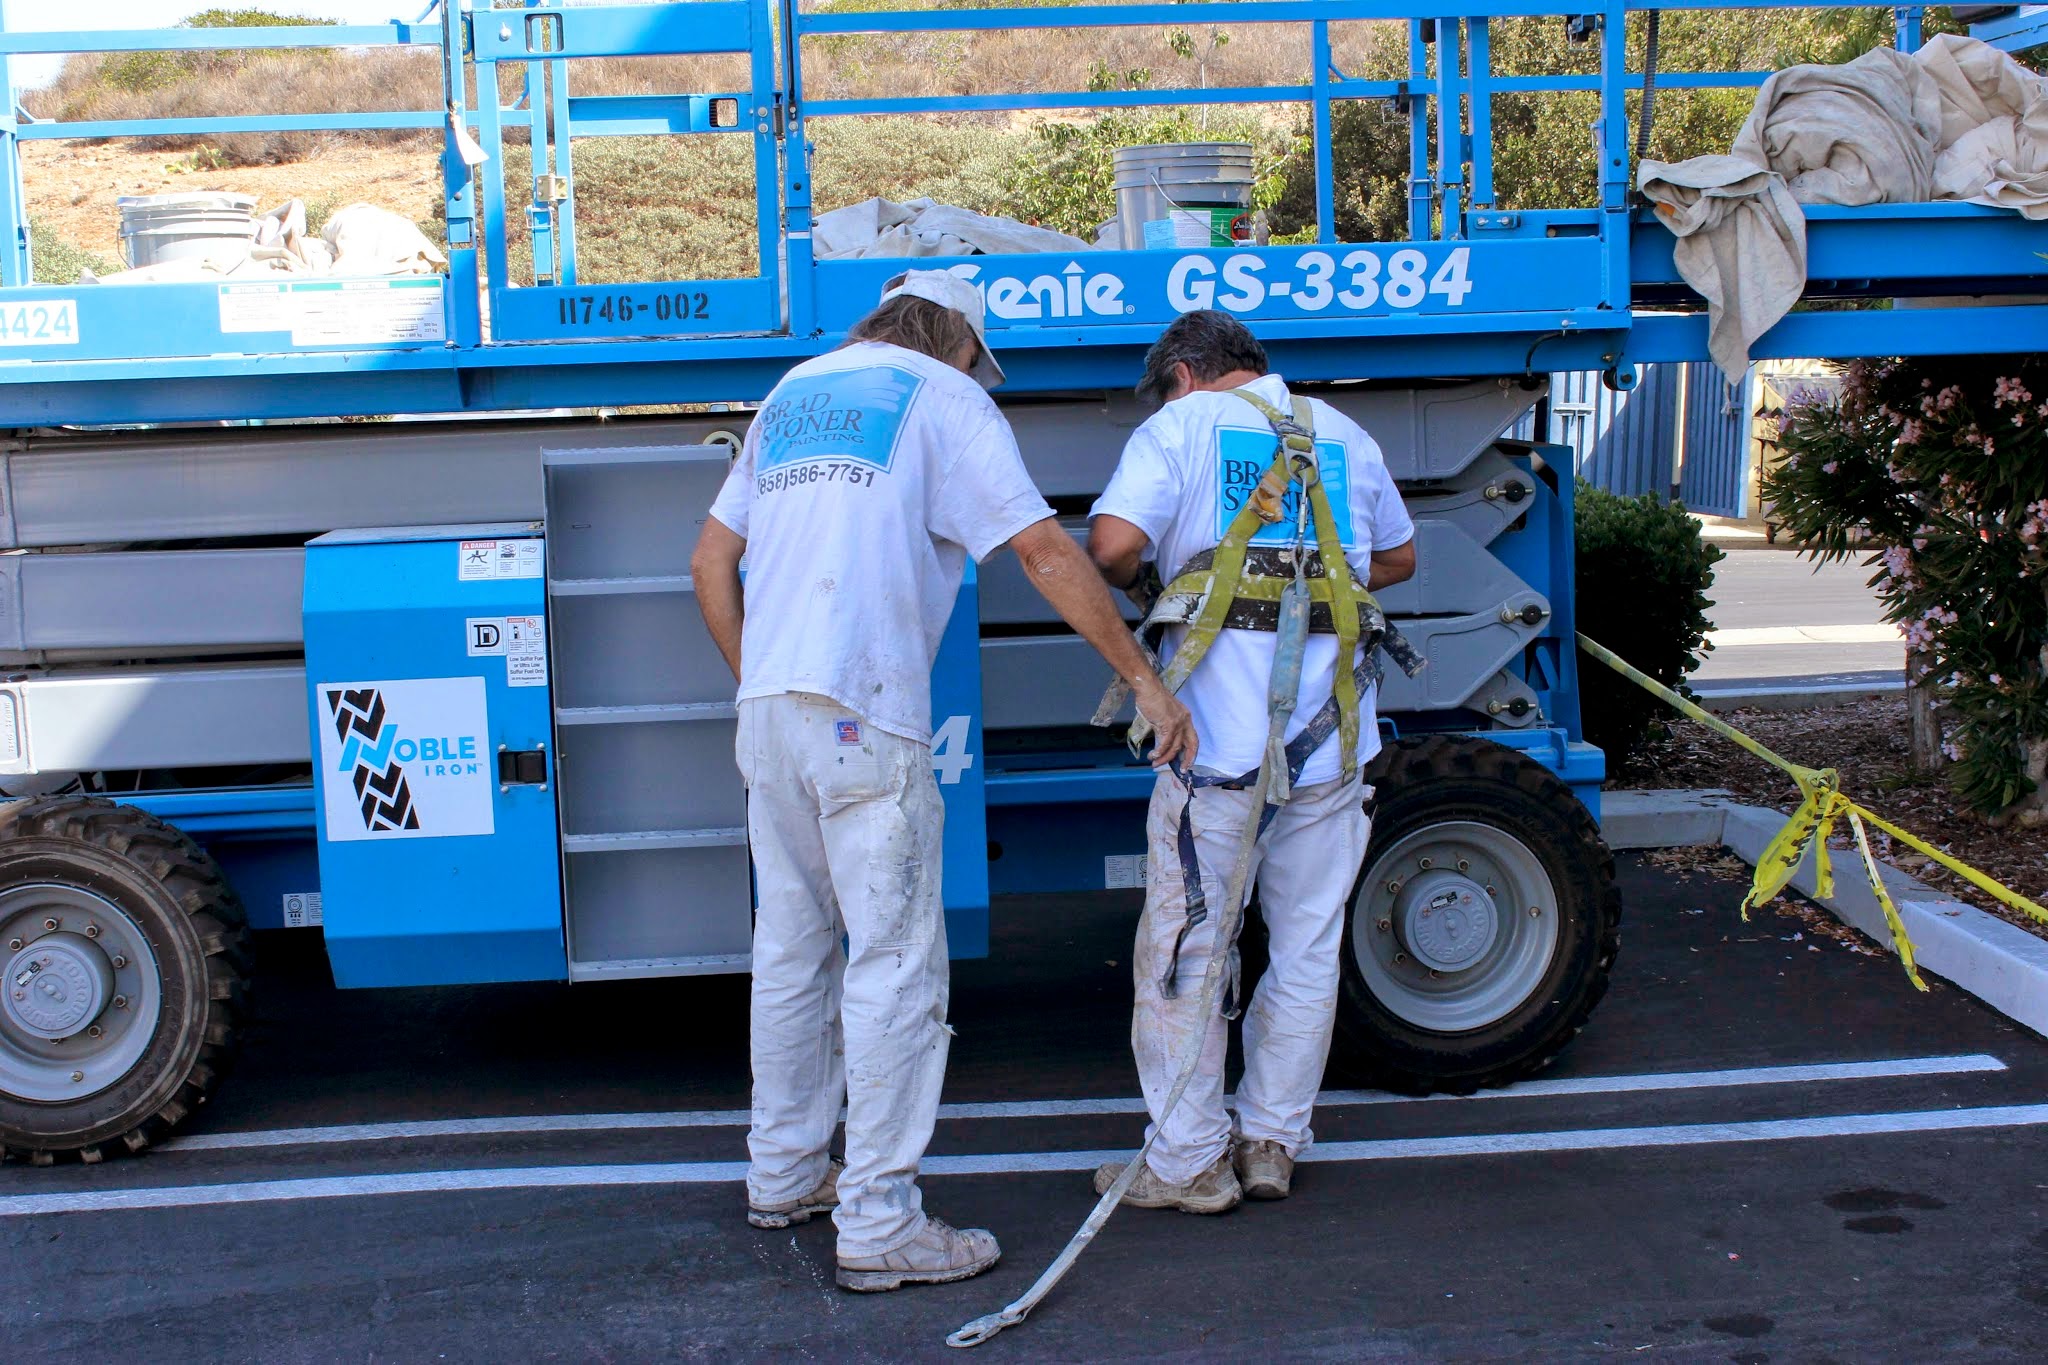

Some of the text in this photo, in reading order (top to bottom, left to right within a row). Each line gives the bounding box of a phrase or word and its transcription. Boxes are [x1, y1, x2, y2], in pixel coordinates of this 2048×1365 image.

[1166, 247, 1474, 314] GS-3384
[560, 292, 709, 325] 11746-002
[762, 392, 831, 425] BRAD
[761, 409, 864, 449] STONER
[788, 433, 865, 448] PAINTING
[1223, 459, 1261, 485] BR
[473, 624, 500, 648] D
[338, 724, 476, 771] NOBLE
[425, 763, 478, 776] IRON
